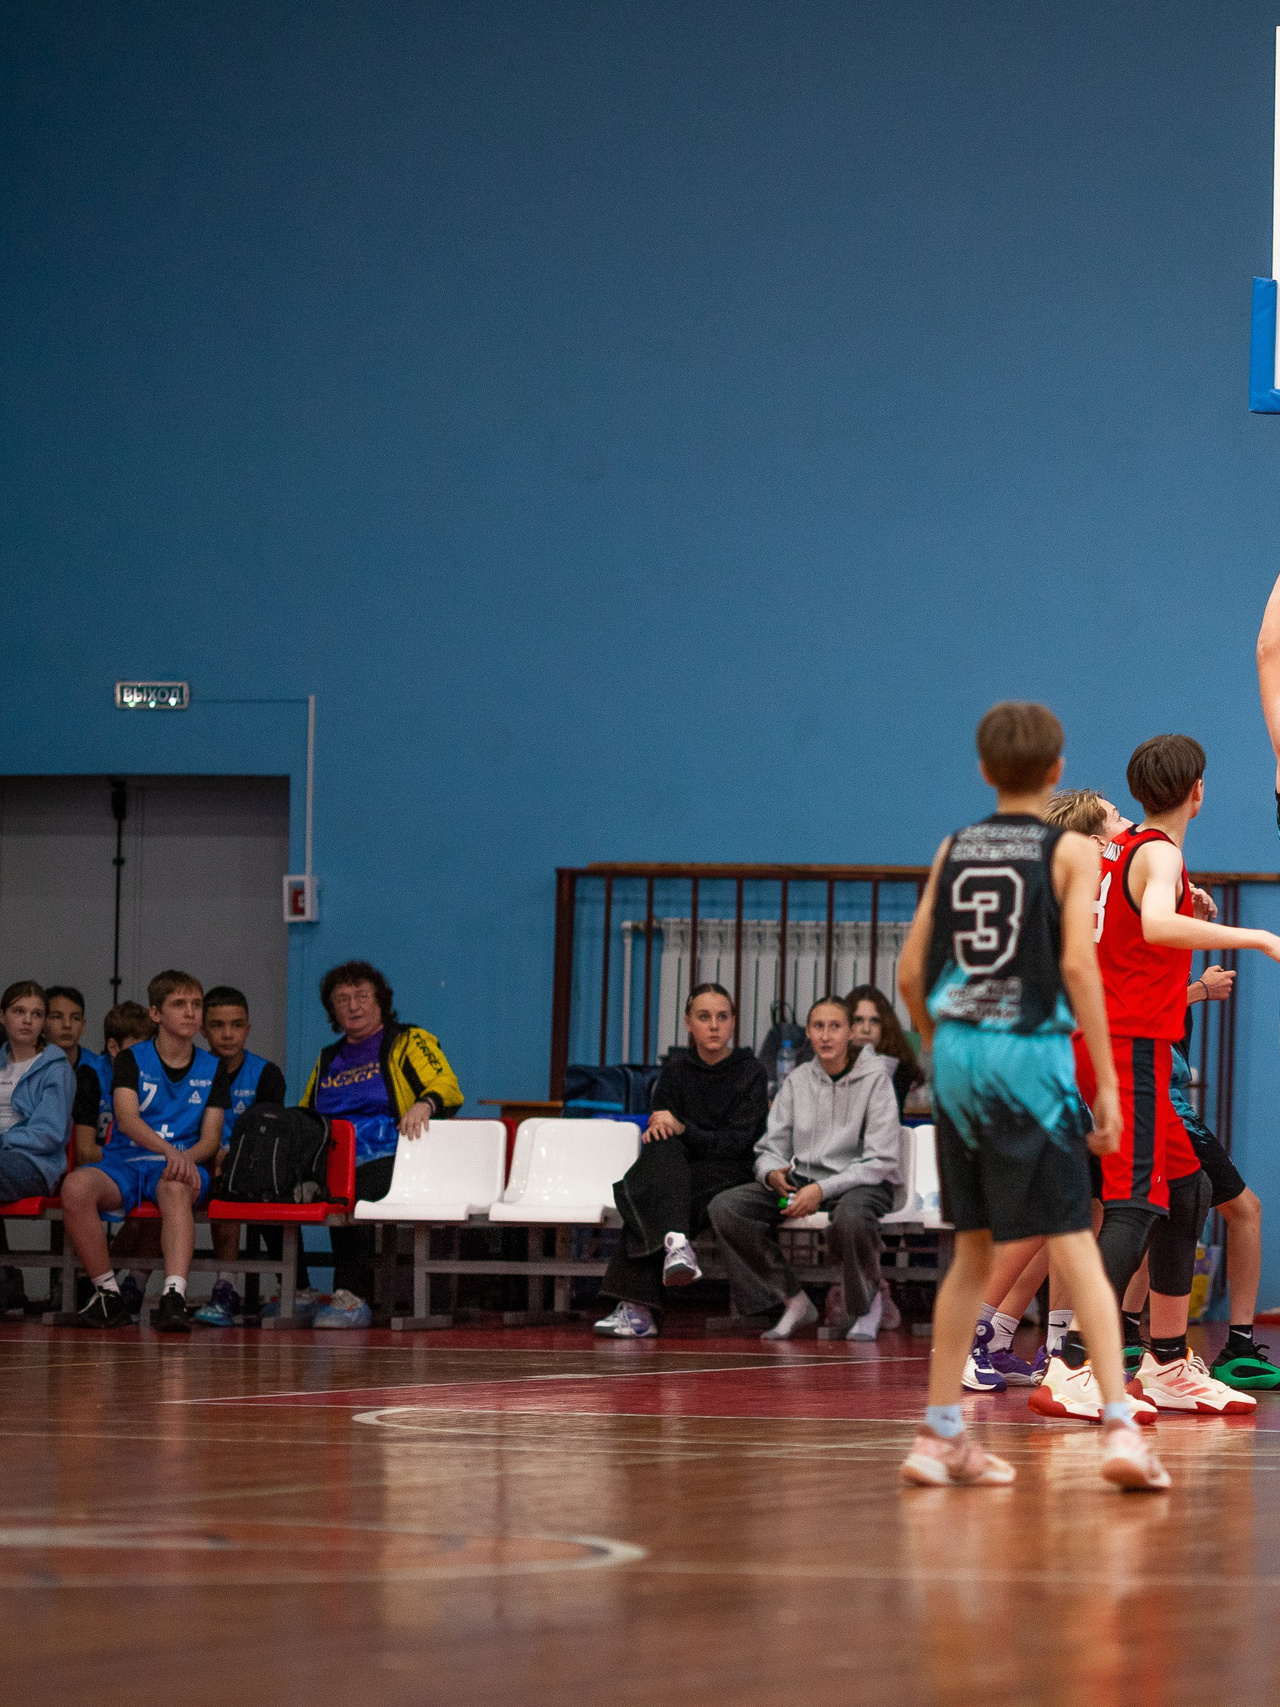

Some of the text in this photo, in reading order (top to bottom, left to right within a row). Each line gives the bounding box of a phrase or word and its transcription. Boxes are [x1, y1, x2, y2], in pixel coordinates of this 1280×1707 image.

[122, 687, 181, 703] ВЫХОД
[951, 866, 1026, 975] 3
[138, 1081, 158, 1113] 7
